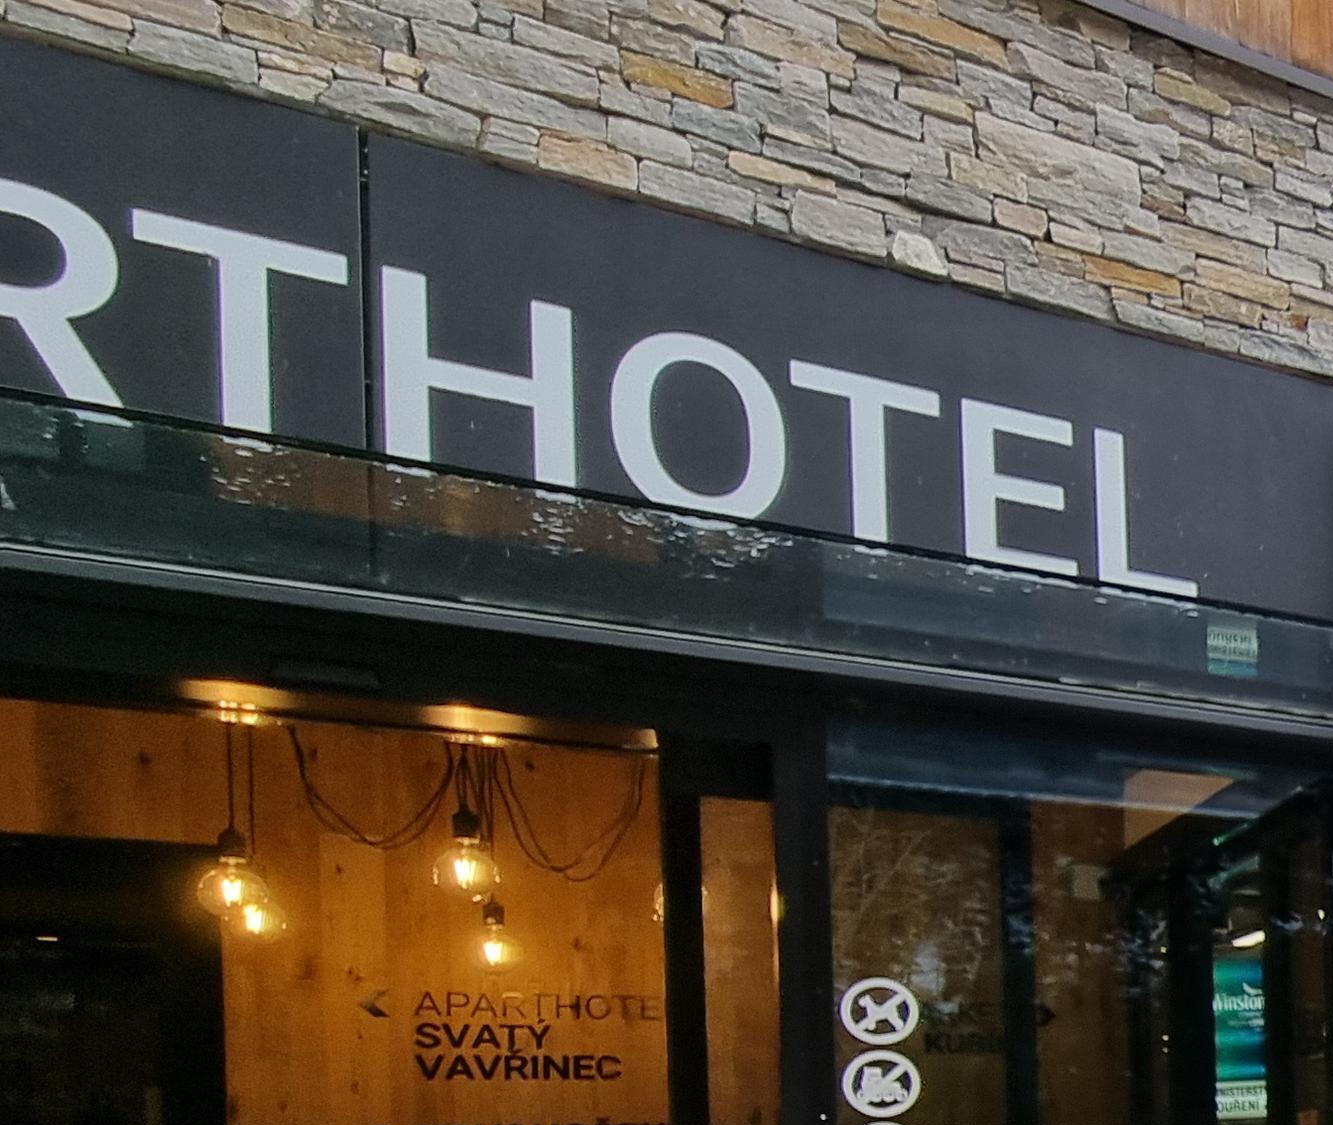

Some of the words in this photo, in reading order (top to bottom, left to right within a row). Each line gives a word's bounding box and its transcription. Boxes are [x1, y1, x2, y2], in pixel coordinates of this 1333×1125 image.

[414, 991, 663, 1022] APARTHOTE
[414, 1018, 551, 1050] SVATÝ
[414, 1049, 622, 1081] VAVŘINEC
